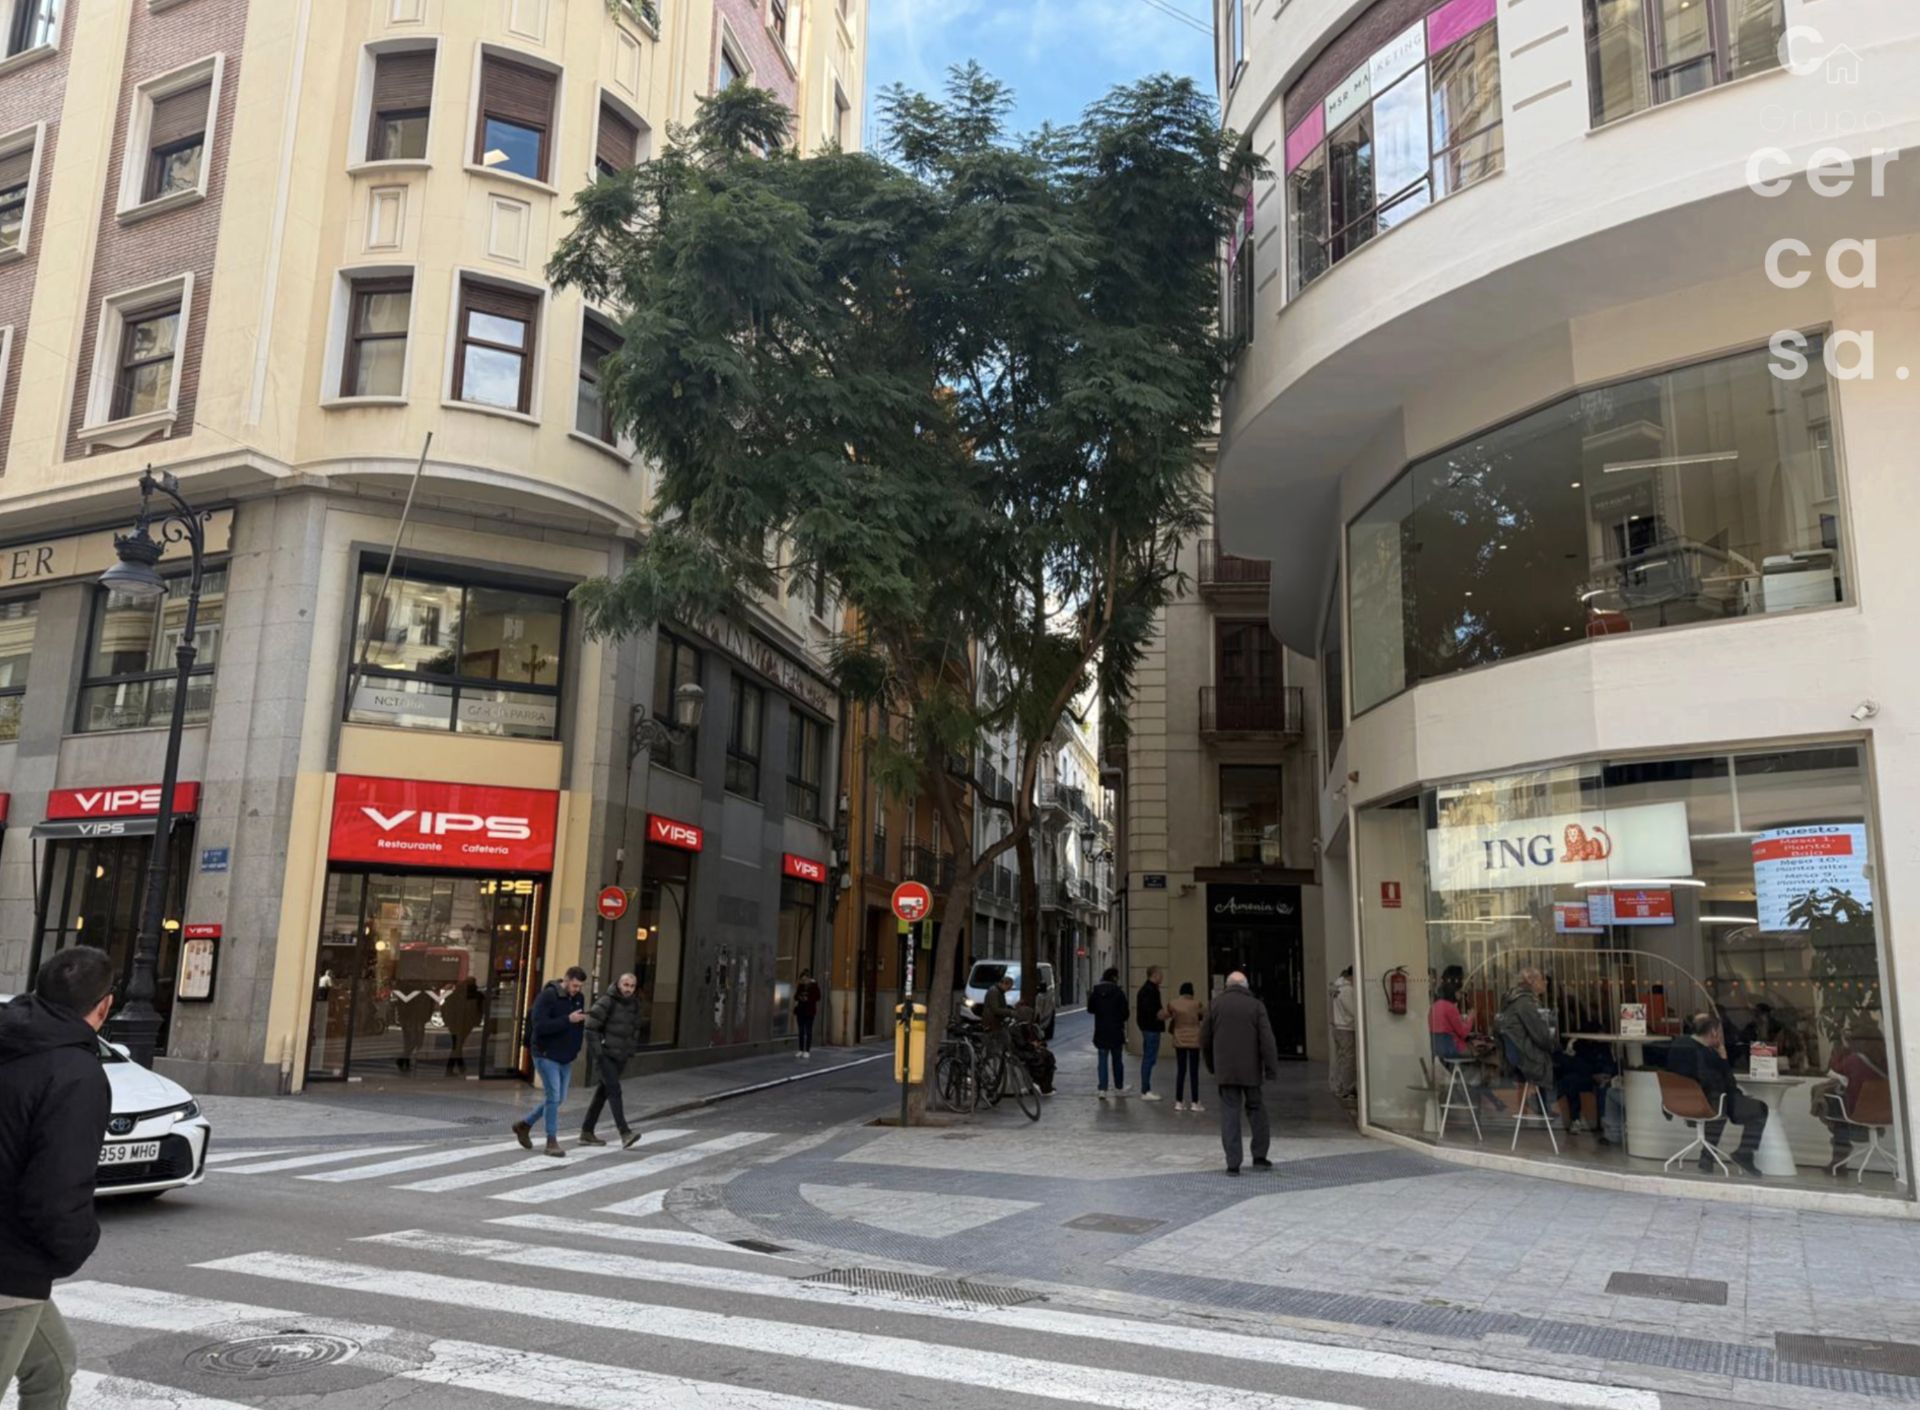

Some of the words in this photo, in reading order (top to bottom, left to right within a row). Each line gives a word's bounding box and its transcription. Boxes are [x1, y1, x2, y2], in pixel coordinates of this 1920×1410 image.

[1328, 90, 1349, 114] MSR
[1353, 33, 1423, 92] MAKETING
[0, 546, 54, 580] ER
[510, 708, 546, 723] PARRA
[75, 789, 163, 812] VIPS
[78, 823, 125, 835] VIPS
[360, 806, 531, 840] VIPS
[1775, 826, 1840, 837] Puesto
[656, 821, 698, 846] VIPS
[378, 838, 443, 852] Restaurante
[1483, 834, 1555, 870] ING
[1784, 843, 1831, 851] Planta
[793, 859, 818, 878] VIPS
[100, 1146, 126, 1162] 959
[130, 1143, 157, 1159] MHG
